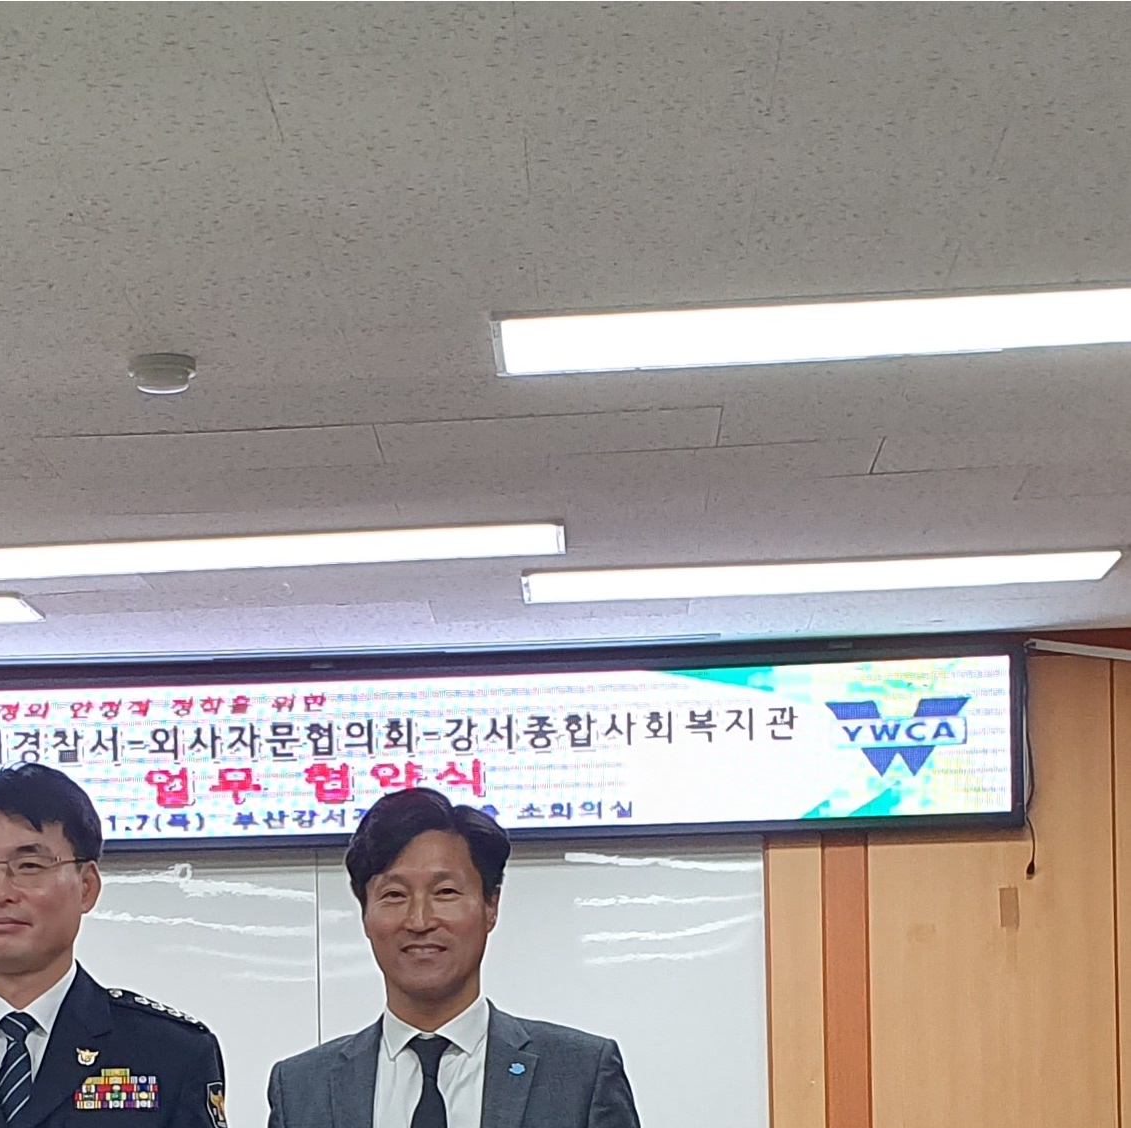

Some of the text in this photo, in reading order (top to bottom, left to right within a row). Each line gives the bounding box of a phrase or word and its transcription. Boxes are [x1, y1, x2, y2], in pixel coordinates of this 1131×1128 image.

[70, 698, 151, 720] 안정적
[272, 693, 328, 713] 위한
[841, 721, 956, 742] YWCA
[517, 799, 633, 821] 소회의실
